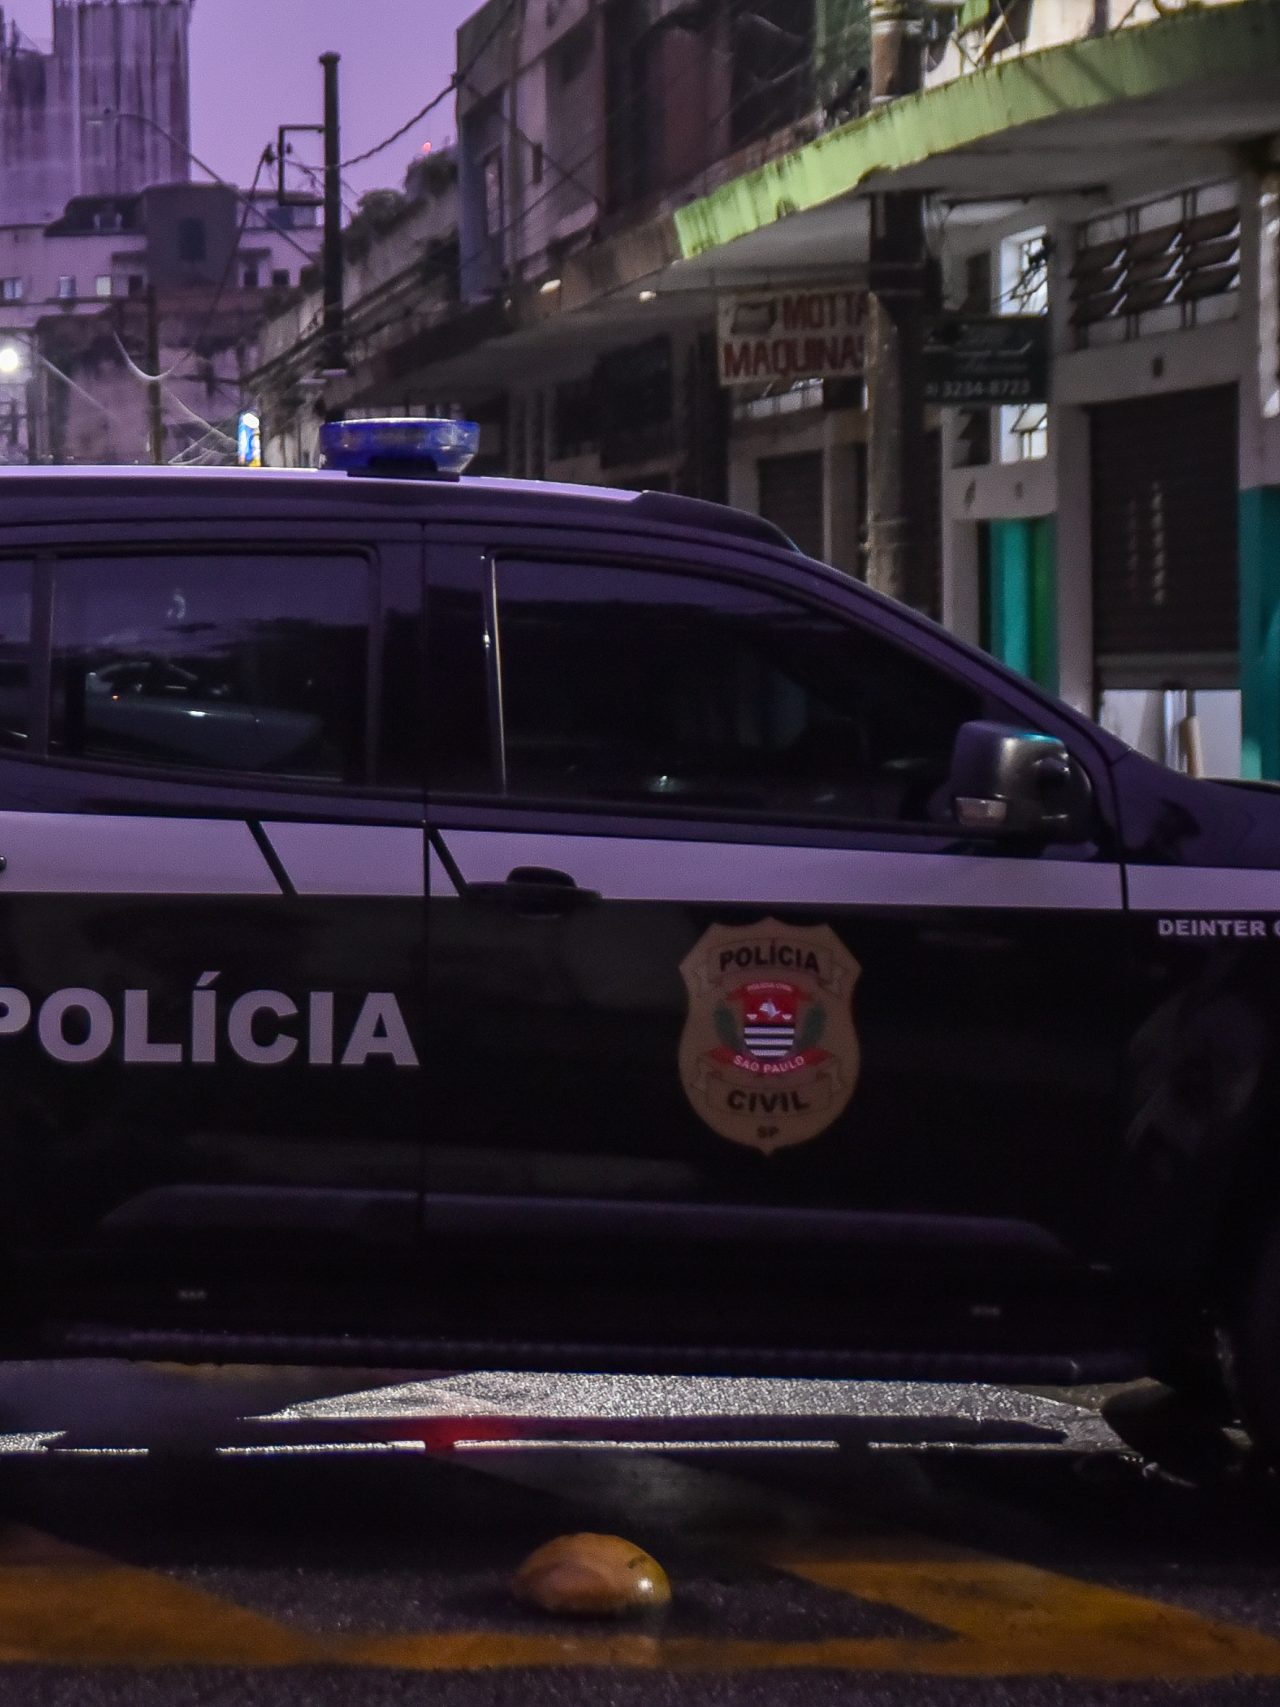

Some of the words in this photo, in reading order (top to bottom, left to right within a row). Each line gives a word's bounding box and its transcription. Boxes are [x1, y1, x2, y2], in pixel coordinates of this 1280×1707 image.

[1158, 919, 1267, 936] DEINTER
[719, 938, 820, 974] POLÍCIA
[763, 1056, 805, 1074] PAULO
[727, 1090, 810, 1113] CIVIL
